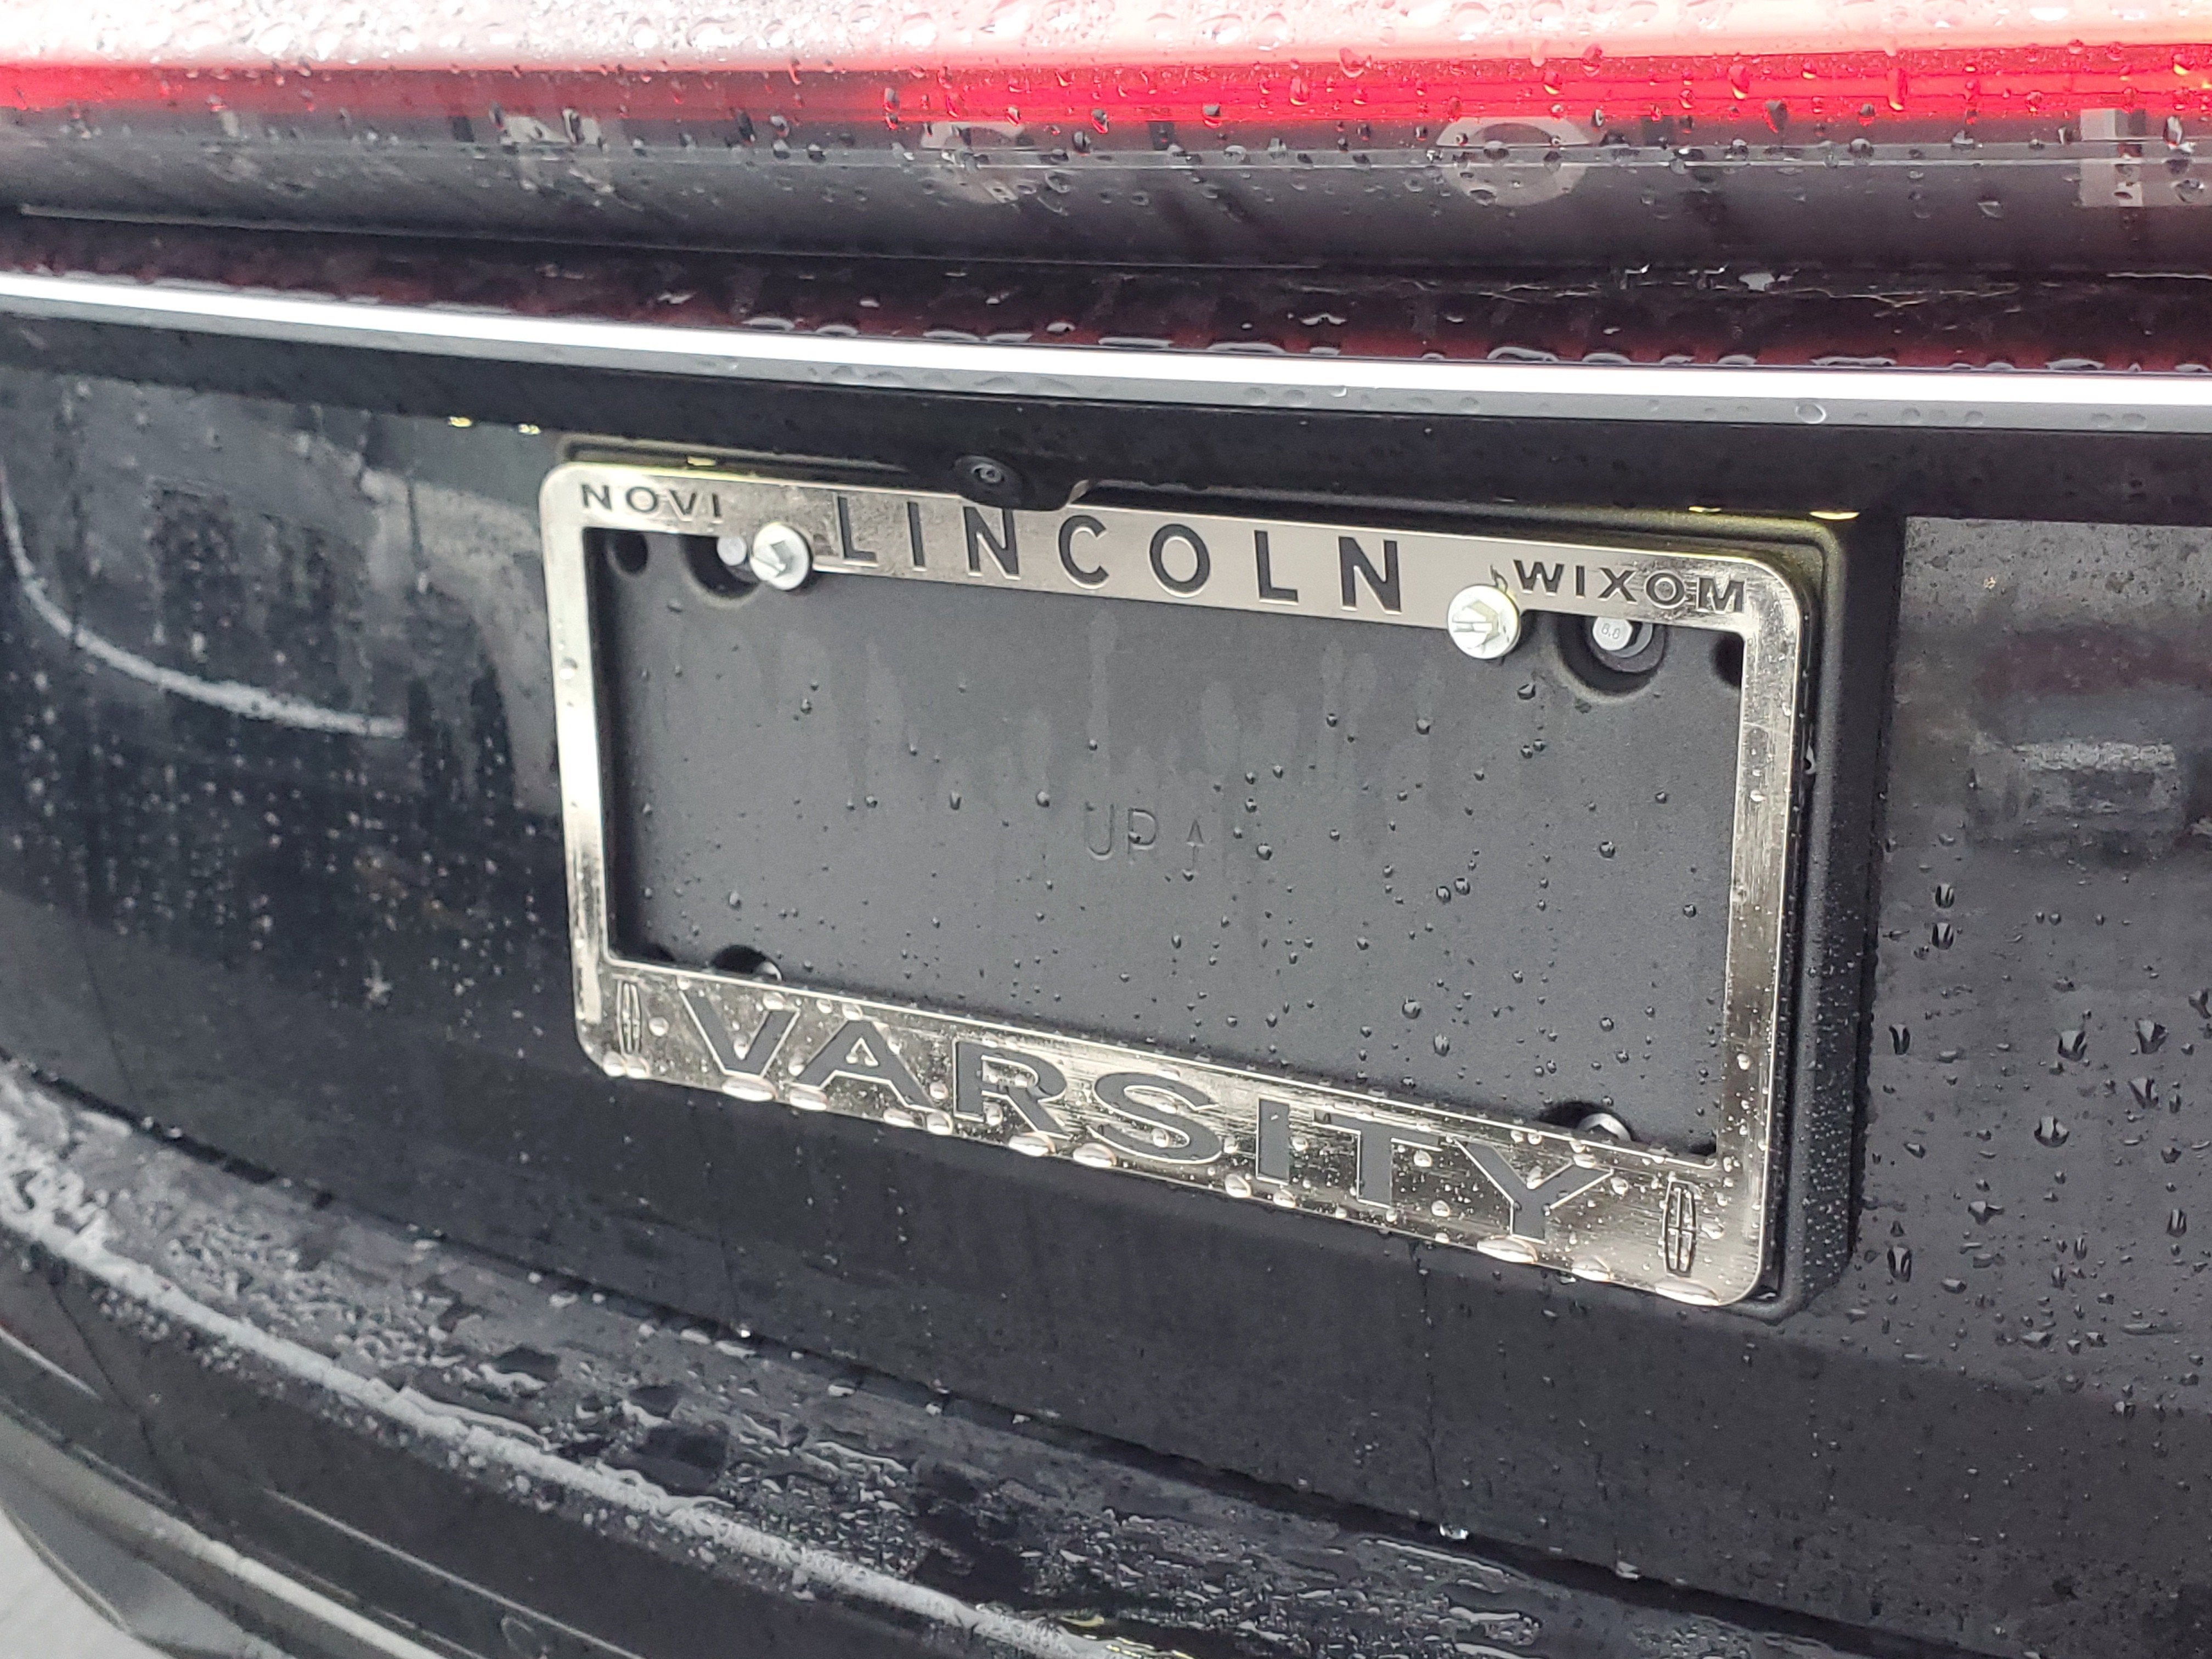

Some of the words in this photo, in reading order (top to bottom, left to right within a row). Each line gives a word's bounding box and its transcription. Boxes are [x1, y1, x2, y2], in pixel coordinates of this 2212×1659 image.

[579, 483, 723, 523] NOVI
[835, 495, 1402, 615] LINCOLN
[1513, 558, 1745, 613] WIXOM
[1084, 802, 1158, 865] UP
[679, 989, 1613, 1244] VARSITY
